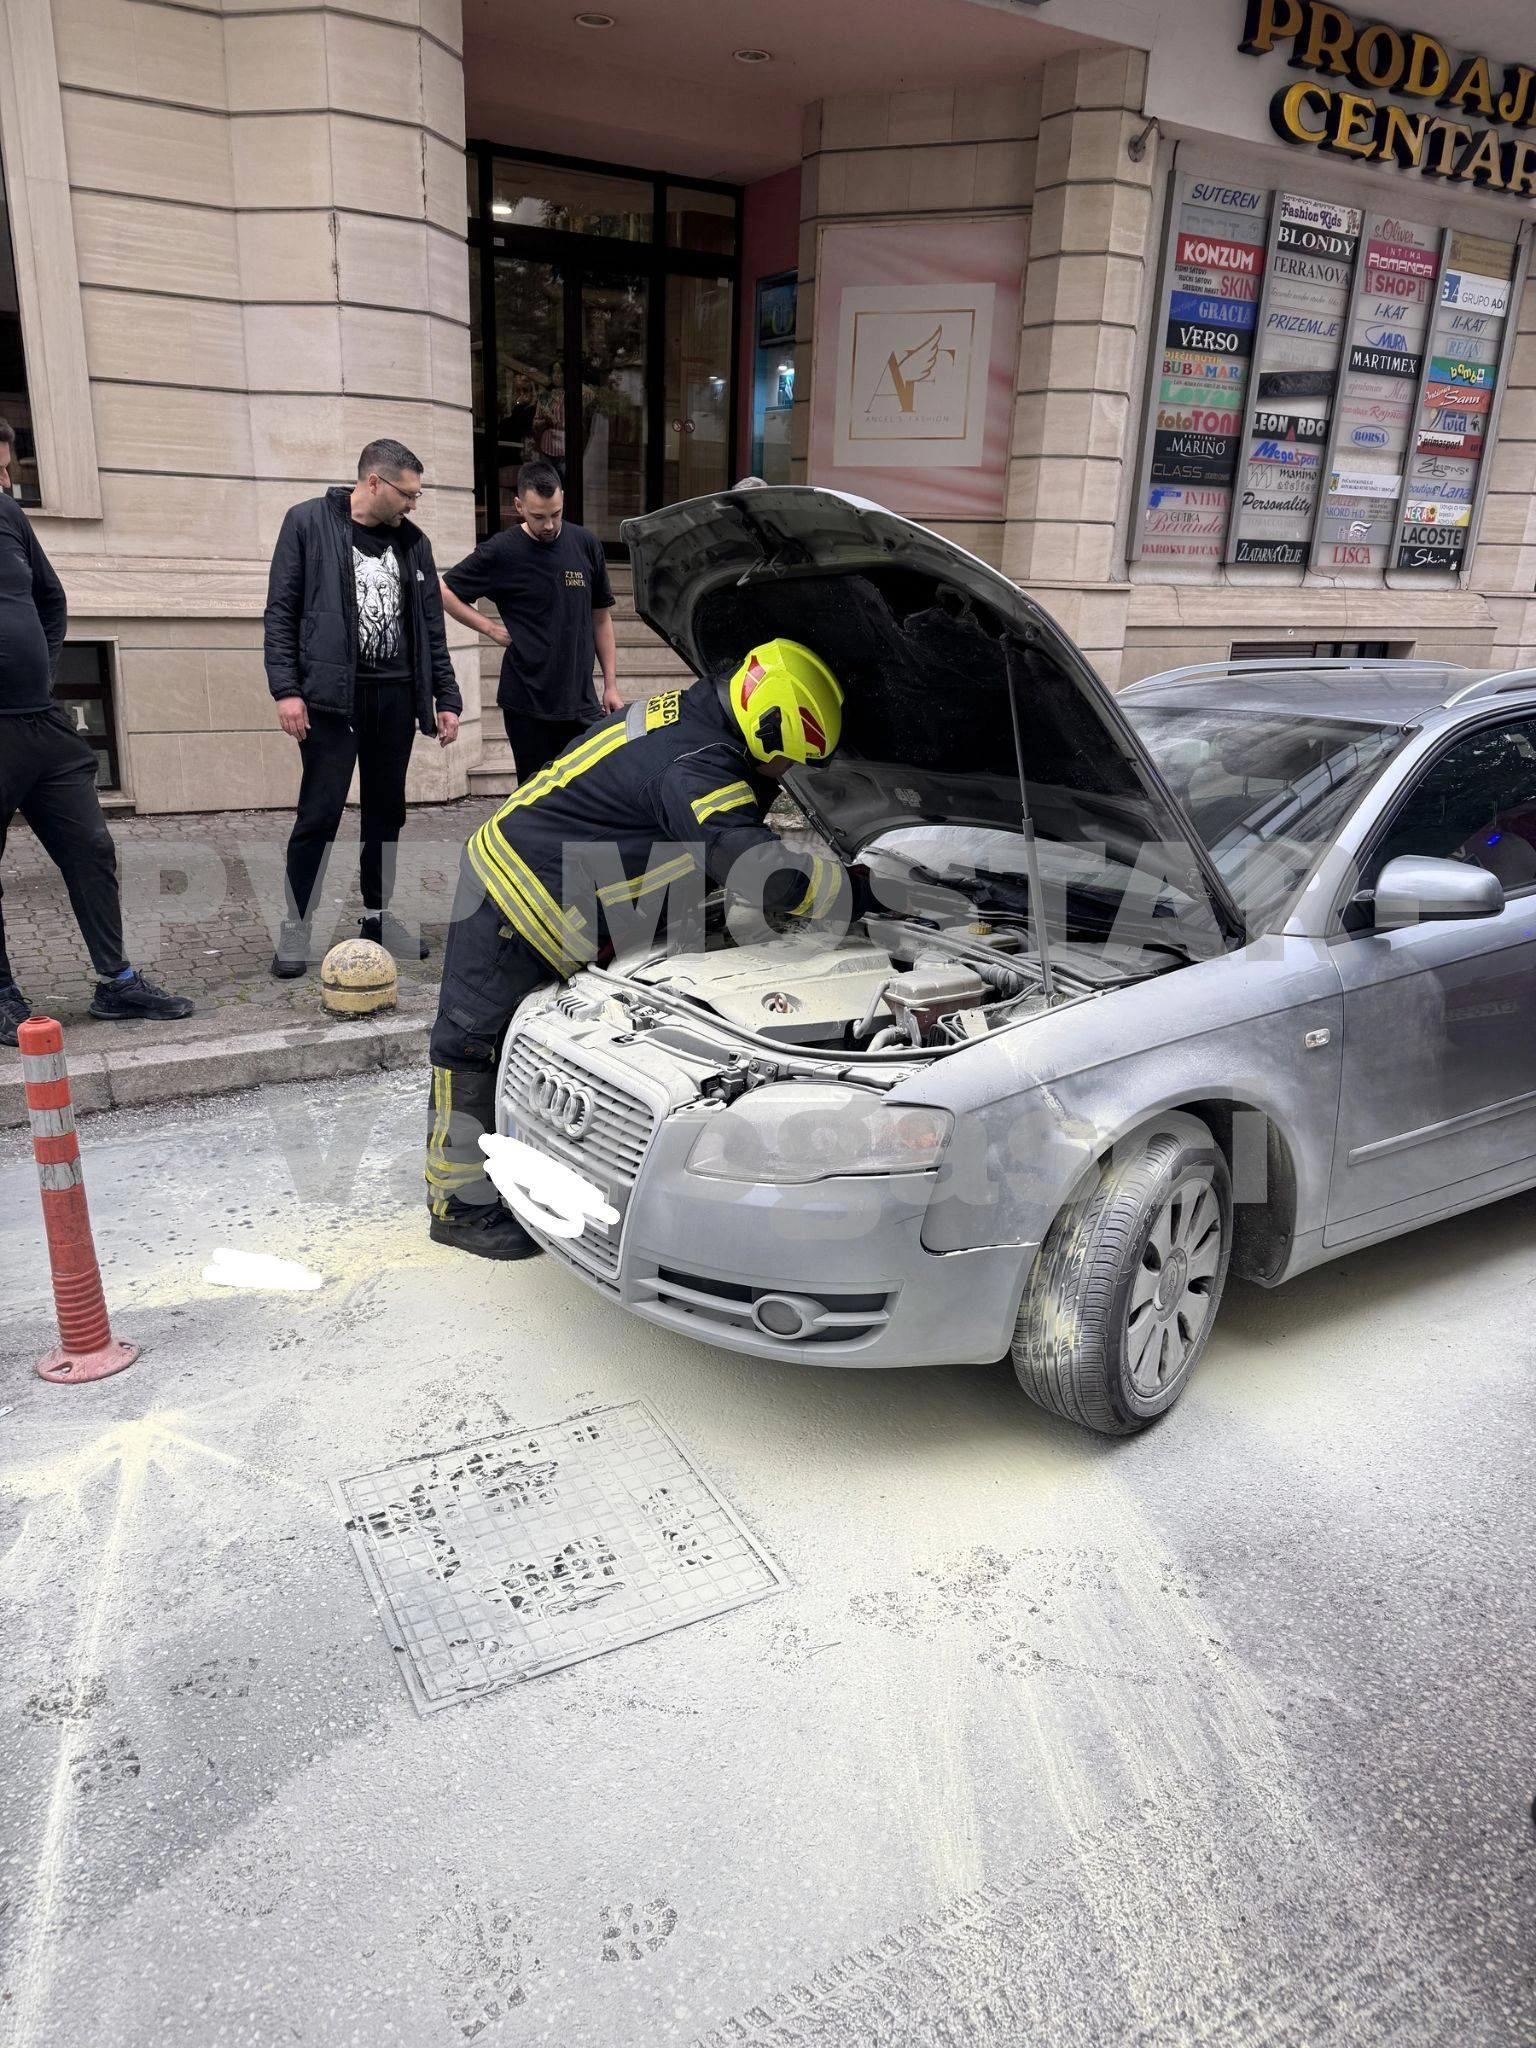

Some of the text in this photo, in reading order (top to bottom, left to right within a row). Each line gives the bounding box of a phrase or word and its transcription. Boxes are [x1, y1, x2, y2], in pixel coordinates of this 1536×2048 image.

[1240, 0, 1536, 127] PRODAJ
[1192, 183, 1261, 210] SUTEREN
[1281, 202, 1342, 229] Fashion Kids
[1278, 226, 1355, 257] BLONDY
[1183, 240, 1255, 271] KONZUM
[1385, 246, 1421, 260] INTIMA
[1274, 256, 1349, 284] TERRANOVA
[1221, 275, 1256, 299] SKIN
[1375, 273, 1416, 297] SHOP
[1462, 292, 1490, 307] GRUPO
[1374, 303, 1409, 321] I-KAT
[1267, 313, 1339, 337] PRIZEMLJE
[1451, 315, 1487, 333] II-KAT
[1180, 325, 1239, 352] VERSO
[1352, 351, 1417, 374] MARTIMEX
[1171, 437, 1226, 456] MARINO
[1354, 430, 1385, 443] BORSA
[1152, 463, 1203, 479] CLASS
[1440, 482, 1470, 500] Lana
[1243, 491, 1313, 517] Personality
[1146, 512, 1224, 534] Bevanda
[1401, 526, 1462, 546] LACOSTE
[1238, 543, 1277, 562] ZLATARNA
[1332, 544, 1371, 564] LISCA
